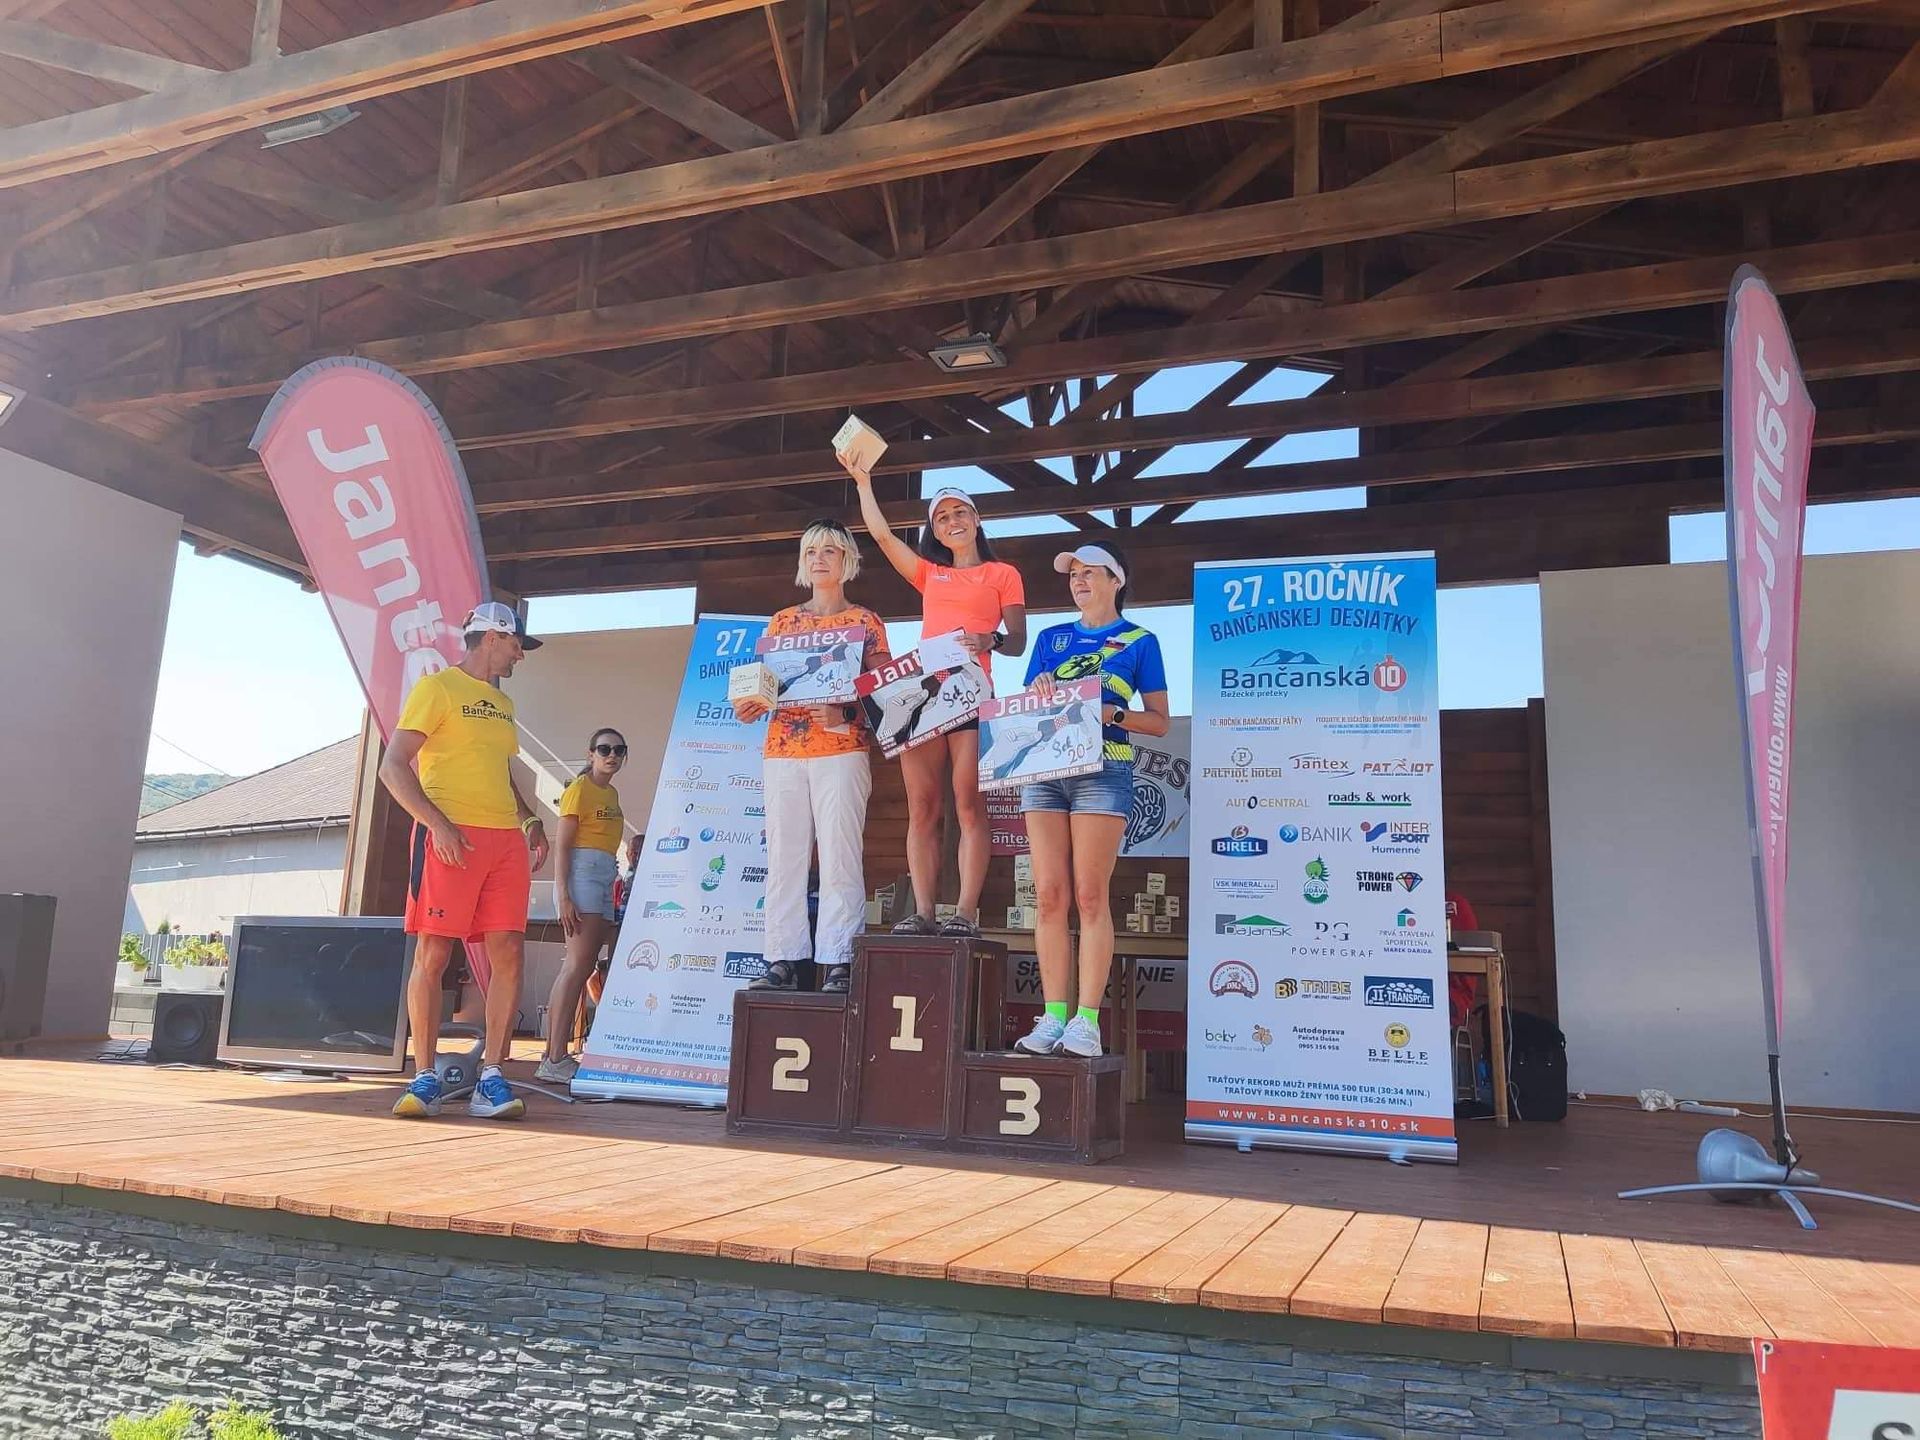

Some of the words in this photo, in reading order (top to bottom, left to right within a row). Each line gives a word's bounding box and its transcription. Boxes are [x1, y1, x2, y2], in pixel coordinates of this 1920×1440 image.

[1223, 575, 1274, 612] 27.
[1283, 563, 1406, 606] ROČNÍK
[1209, 607, 1321, 642] BANČANSKEJ
[1331, 607, 1418, 636] DESIATKY
[716, 628, 753, 656] 27.
[770, 630, 849, 652] Jantex
[870, 650, 923, 689] Jant
[1221, 664, 1369, 689] Bančanská
[1379, 665, 1400, 688] 10
[1221, 689, 1254, 699] Bežecké
[1257, 689, 1288, 700] preteky
[1293, 758, 1350, 770] Jantex
[1203, 768, 1248, 778] Patriot
[1251, 768, 1282, 778] hotel
[728, 777, 764, 788] Jante
[1226, 796, 1311, 809] AUTOCENTRAL
[1328, 791, 1360, 802] roads
[1366, 791, 1375, 802] &
[1382, 791, 1411, 802] work
[1390, 822, 1429, 833] INTER
[715, 830, 753, 845] BANIK
[1302, 826, 1352, 842] BANIK
[1391, 834, 1430, 843] SPORT
[1216, 841, 1262, 853] BIRELL
[1372, 846, 1420, 855] Humenné
[742, 867, 768, 875] STRONG
[1356, 871, 1394, 881] STRONG
[740, 875, 765, 883] POWER
[1215, 880, 1230, 888] VSK
[1231, 880, 1262, 888] MINERAL
[1359, 881, 1392, 892] POWER
[682, 955, 718, 967] TRIBE
[1302, 980, 1351, 994] TRIBE
[890, 995, 924, 1052] 1
[1292, 1026, 1345, 1036] Autodoprava
[1368, 1048, 1429, 1060] BELLE
[772, 1037, 811, 1093] 2
[1247, 1078, 1280, 1087] REKORD
[1283, 1080, 1305, 1088] MUŽI
[1307, 1081, 1339, 1091] PRÉMIA
[1342, 1084, 1357, 1092] 500
[1359, 1085, 1376, 1093] EUR
[1378, 1086, 1404, 1096] (30:34
[1406, 1089, 1431, 1099] MIN.)
[1264, 1089, 1298, 1098] REKORD
[1300, 1089, 1322, 1100] ŽENY
[1325, 1093, 1339, 1101] 100
[1341, 1094, 1358, 1102] EUR
[1360, 1095, 1386, 1105] (36:26
[1388, 1098, 1413, 1107] MIN.)
[999, 1077, 1041, 1136] 3
[1219, 1108, 1420, 1132] www.bancanska10.sk
